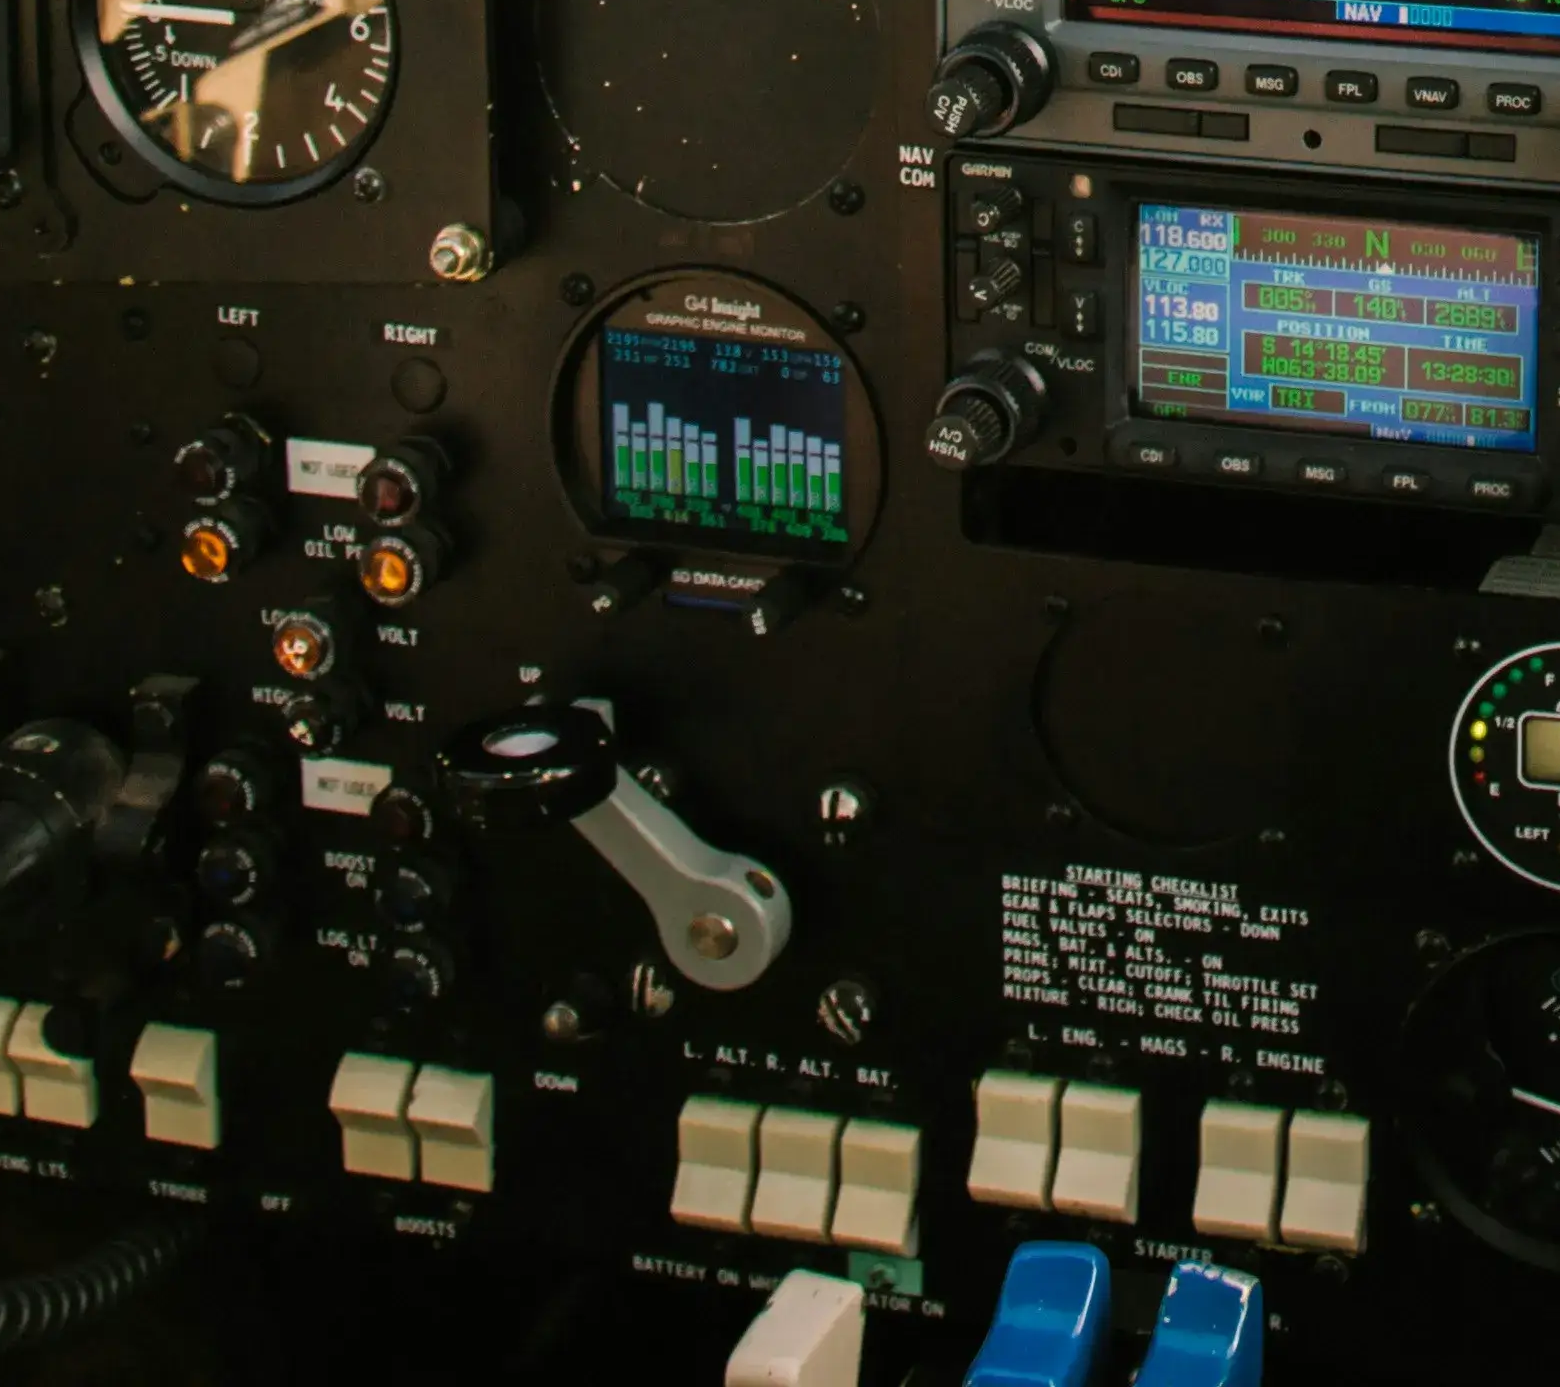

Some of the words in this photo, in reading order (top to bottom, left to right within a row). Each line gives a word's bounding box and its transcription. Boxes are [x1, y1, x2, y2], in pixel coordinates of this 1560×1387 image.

[1345, 2, 1382, 21] NAV
[1176, 70, 1203, 85] OBS
[1256, 76, 1284, 91] MSG
[1338, 82, 1362, 96] FPL
[1414, 87, 1446, 103] VNAV
[1496, 93, 1530, 108] PROC
[218, 308, 259, 326] LEFT
[1144, 297, 1219, 322] 113.80
[384, 325, 436, 345] RIGHT
[1145, 319, 1219, 345] 115.80
[1065, 863, 1142, 888] STARTING
[1152, 876, 1239, 898] CHECKLIST
